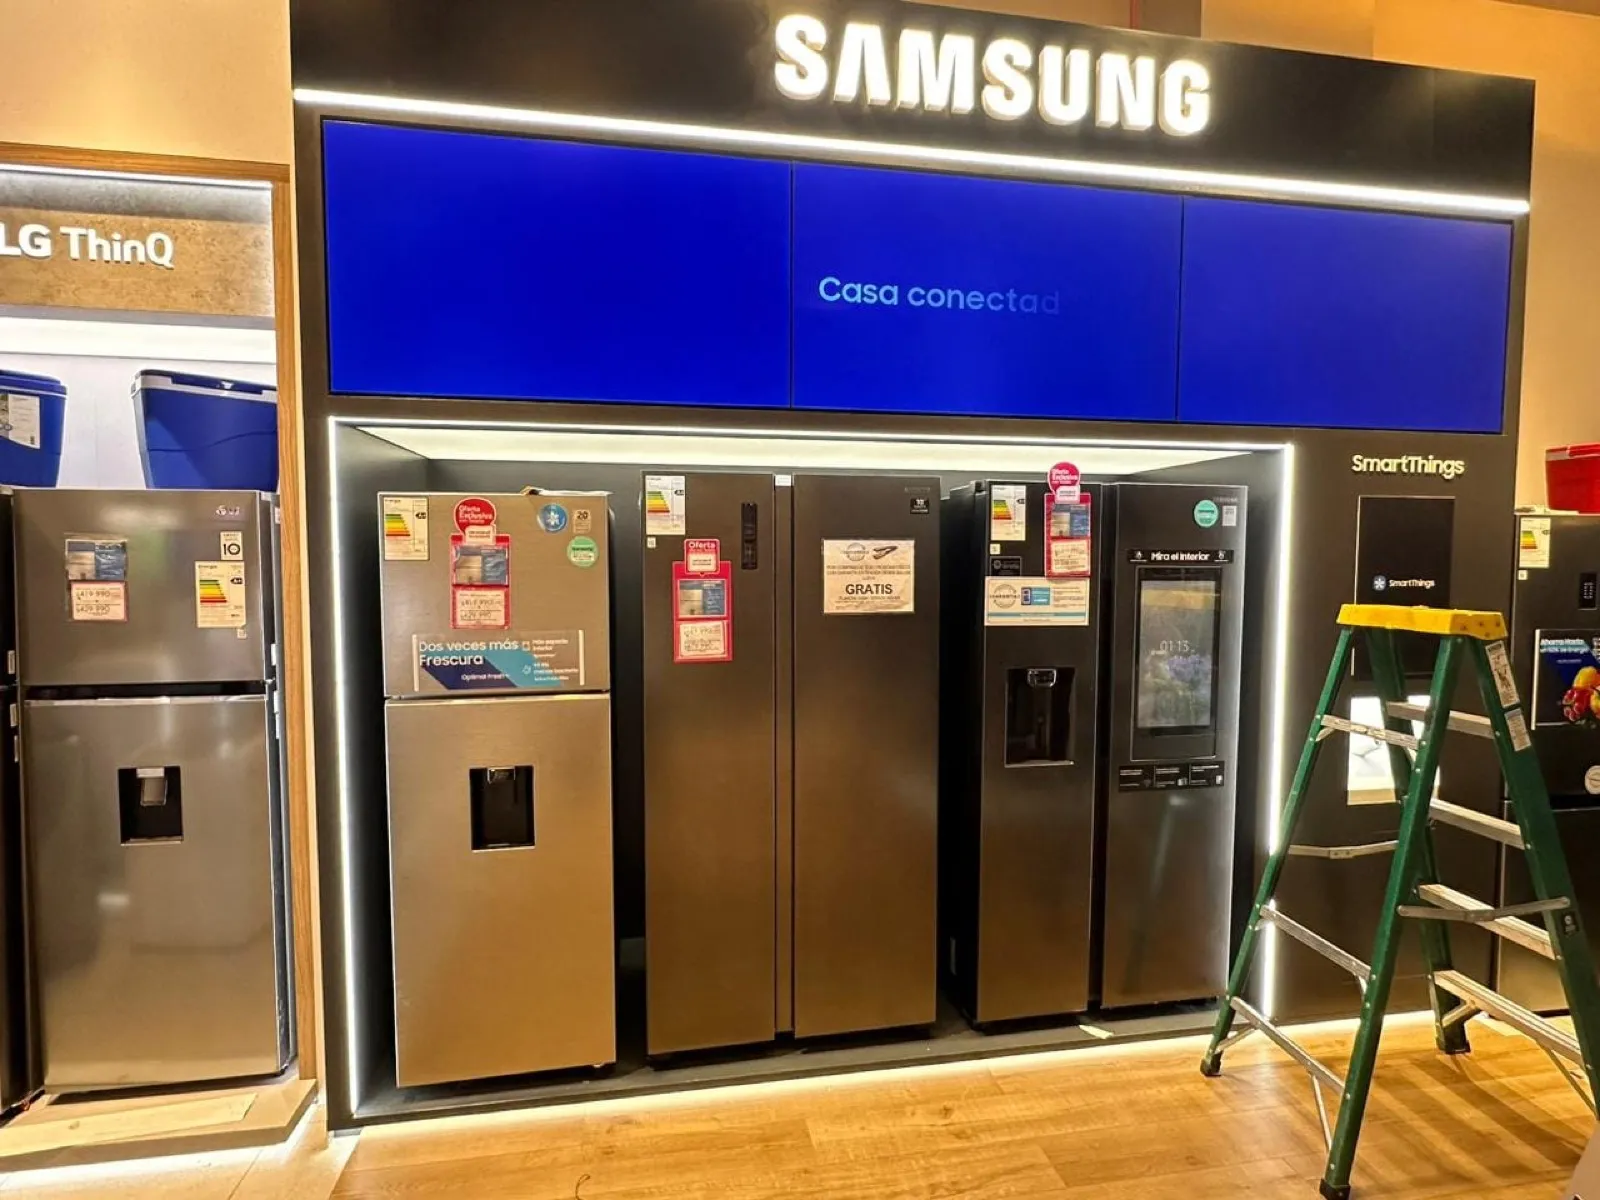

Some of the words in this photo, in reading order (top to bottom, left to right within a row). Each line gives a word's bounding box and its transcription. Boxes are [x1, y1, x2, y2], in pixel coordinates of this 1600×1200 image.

[774, 13, 1211, 136] SAMSUNG
[0, 222, 51, 257] LG
[60, 226, 174, 269] ThinQ
[818, 276, 898, 306] Casa
[1351, 454, 1465, 480] SmartThings
[688, 541, 716, 549] Oferta
[845, 583, 893, 595] GRATIS
[1389, 579, 1435, 589] SmartThings
[420, 641, 444, 652] Dos
[447, 641, 486, 651] veces
[489, 638, 519, 650] más
[419, 654, 483, 667] Frescura
